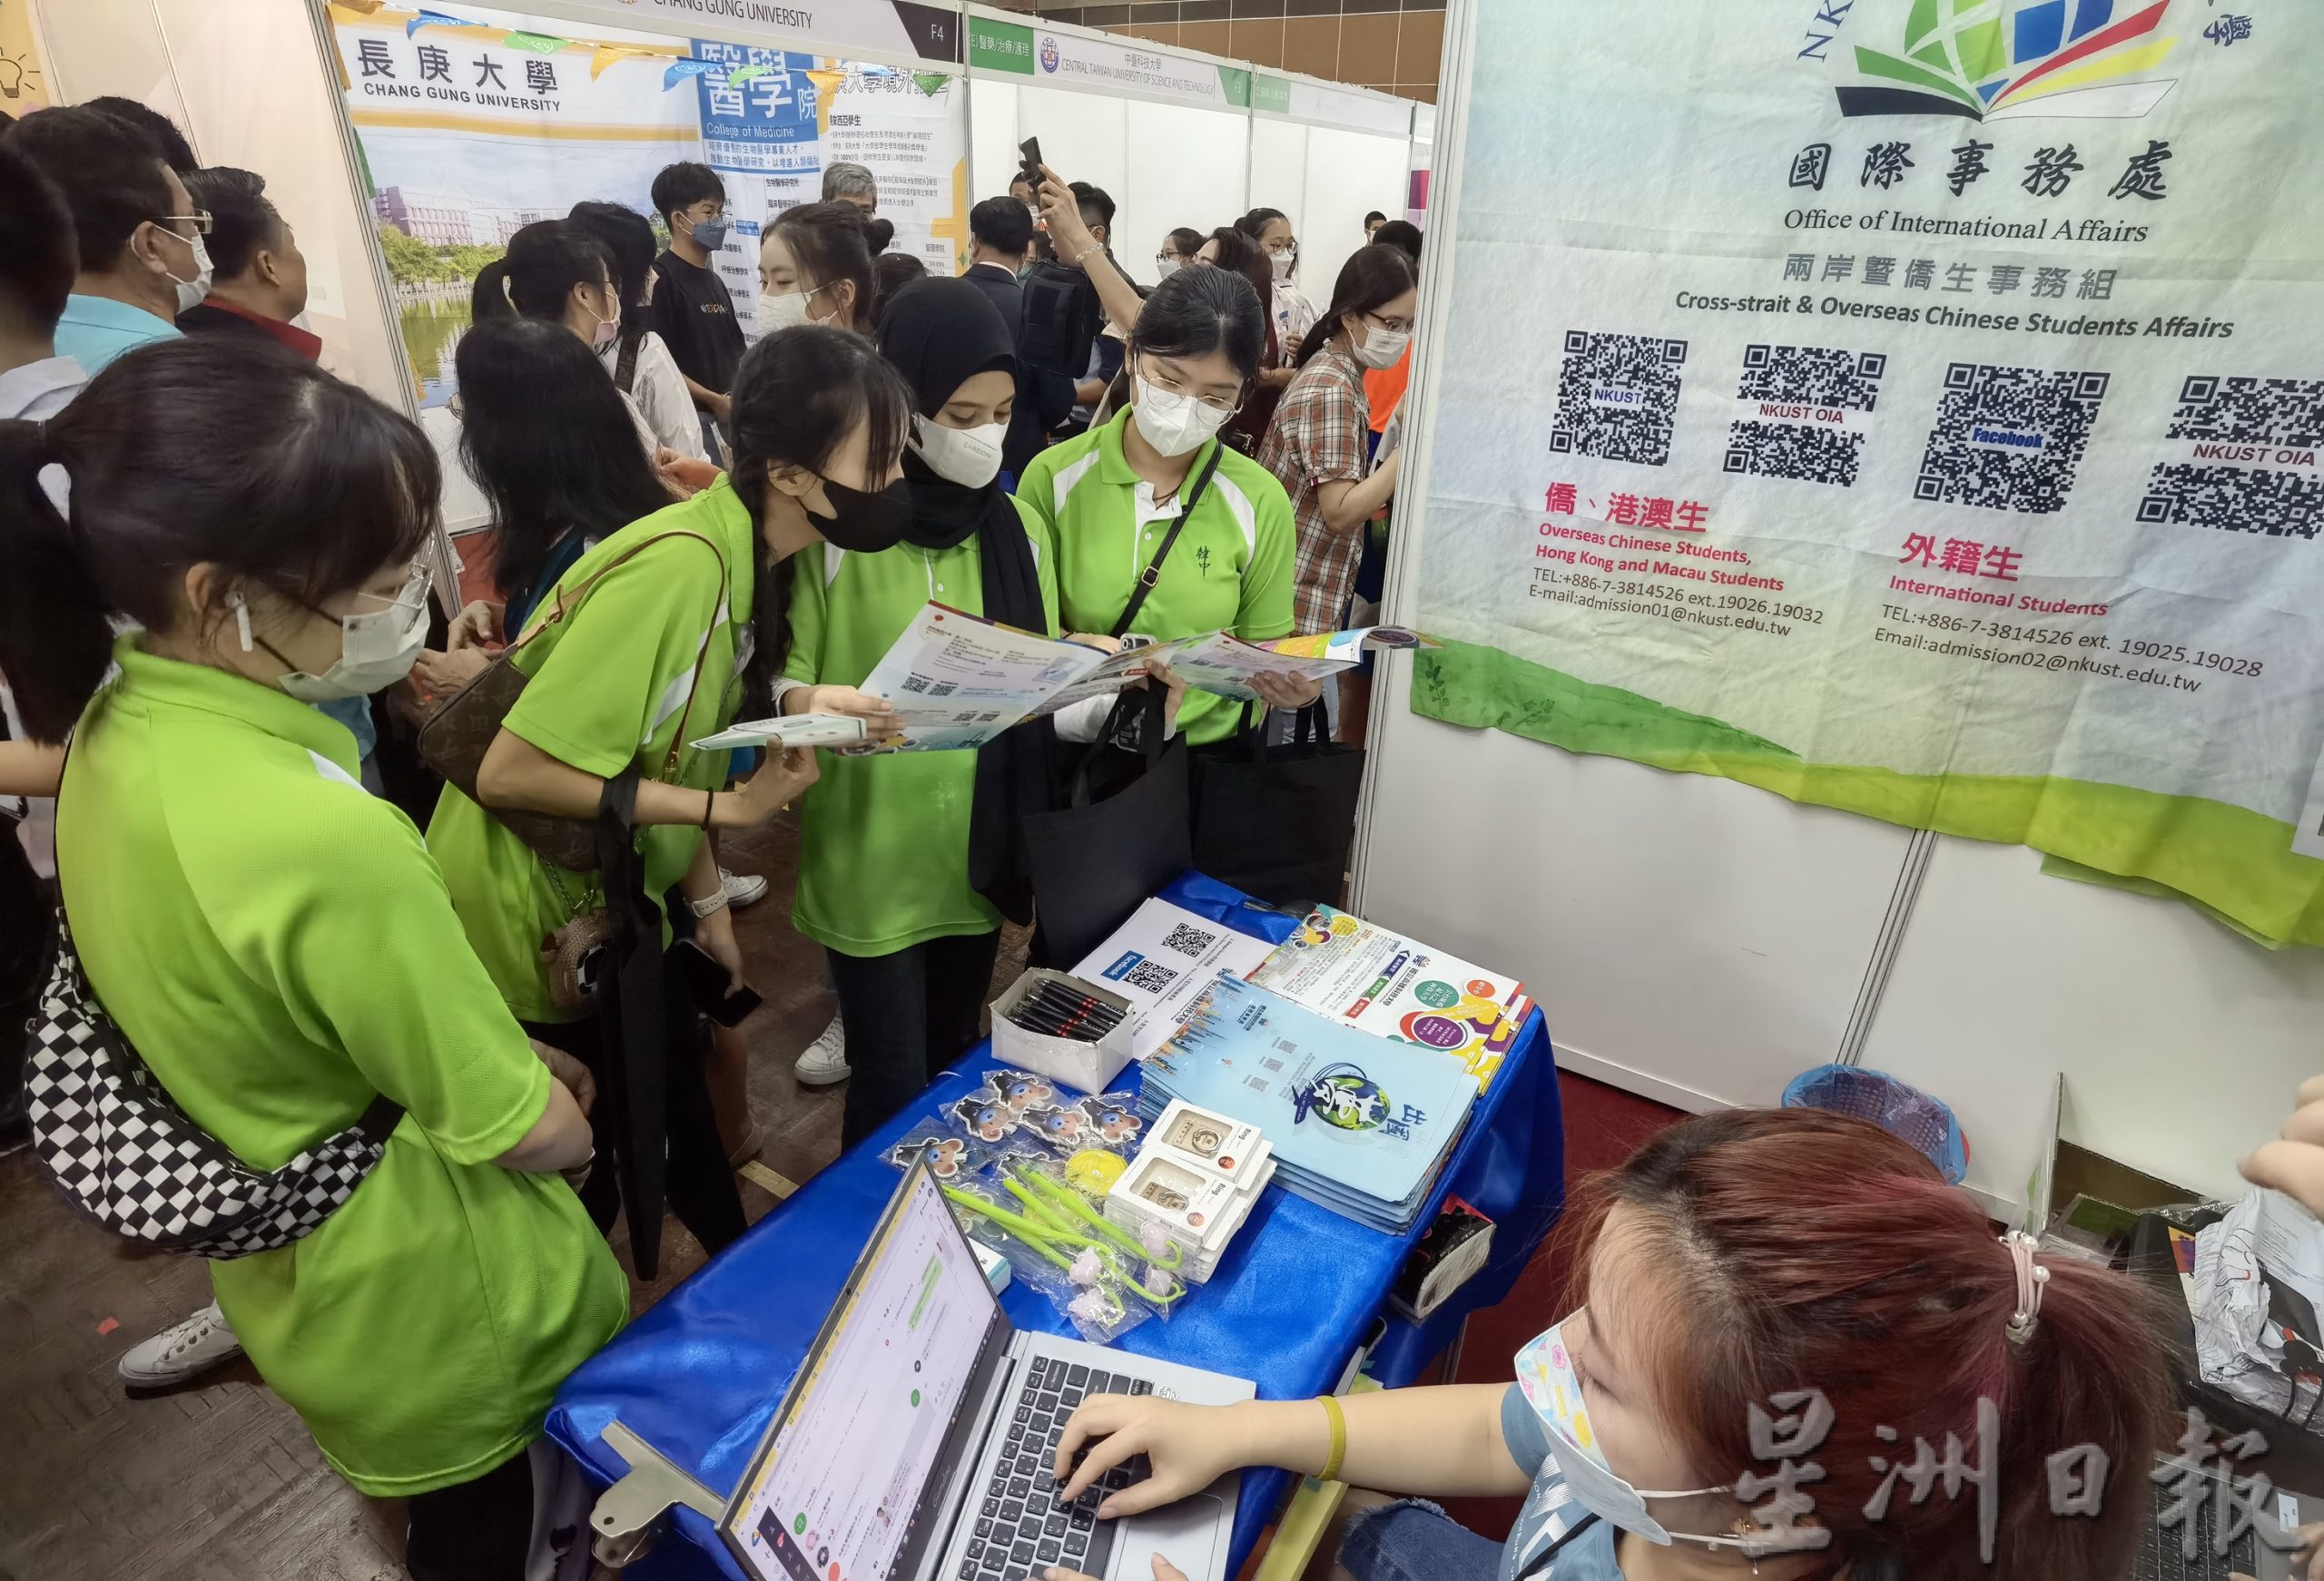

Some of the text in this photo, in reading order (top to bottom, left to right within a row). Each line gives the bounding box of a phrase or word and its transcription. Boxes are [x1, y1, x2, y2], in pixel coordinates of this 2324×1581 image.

[705, 0, 744, 18] GUNG
[746, 4, 812, 29] UNIVERSITY
[931, 24, 944, 42] F4
[358, 38, 557, 94] 長庚大學
[1061, 58, 1088, 74] CENTRAL
[1088, 63, 1112, 79] TAIWAN
[1112, 67, 1142, 83] UNIVERSITY
[1150, 74, 1171, 88] SCIENCE
[1171, 78, 1183, 90] AND
[1183, 79, 1214, 94] TECHNOLOGY
[364, 83, 560, 112] CHANG GUNG UNIVERSITY
[707, 122, 795, 139] College of Medicine
[1788, 139, 2173, 201] 國際事務處
[1784, 209, 2149, 242] Office of International Affairs
[1783, 253, 2117, 300] 兩岸暨僑生事務組
[1676, 290, 2234, 339] Cross-strait & Overseas Chinese Students Affairs
[1593, 388, 1641, 405] NKUST
[1759, 403, 1844, 424] NKUST OIA
[1972, 427, 2043, 448] Facebook
[2192, 444, 2315, 466] NKUST OIA
[1544, 481, 1709, 534] 僑、港澳生
[1539, 522, 1751, 566] Overseas Chinese Students,
[1898, 532, 2023, 582] 外籍生
[1535, 545, 1785, 592] Hong Kong and Macau Students
[1529, 584, 1791, 637] E-mail:admission01@nkust.edu.tw
[1533, 566, 1823, 624] TEL:+886-7-3814526 ext.19026.19032
[1889, 575, 2110, 617] International Students
[1875, 627, 2202, 692] Email:admission02@nkust.edu.tw
[1881, 604, 2263, 678] TEL:+886-7-3814526 ext. 19025.19028
[1108, 954, 1137, 977] facebook
[1238, 1128, 1252, 1140] Ring
[1211, 1183, 1226, 1196] Ring
